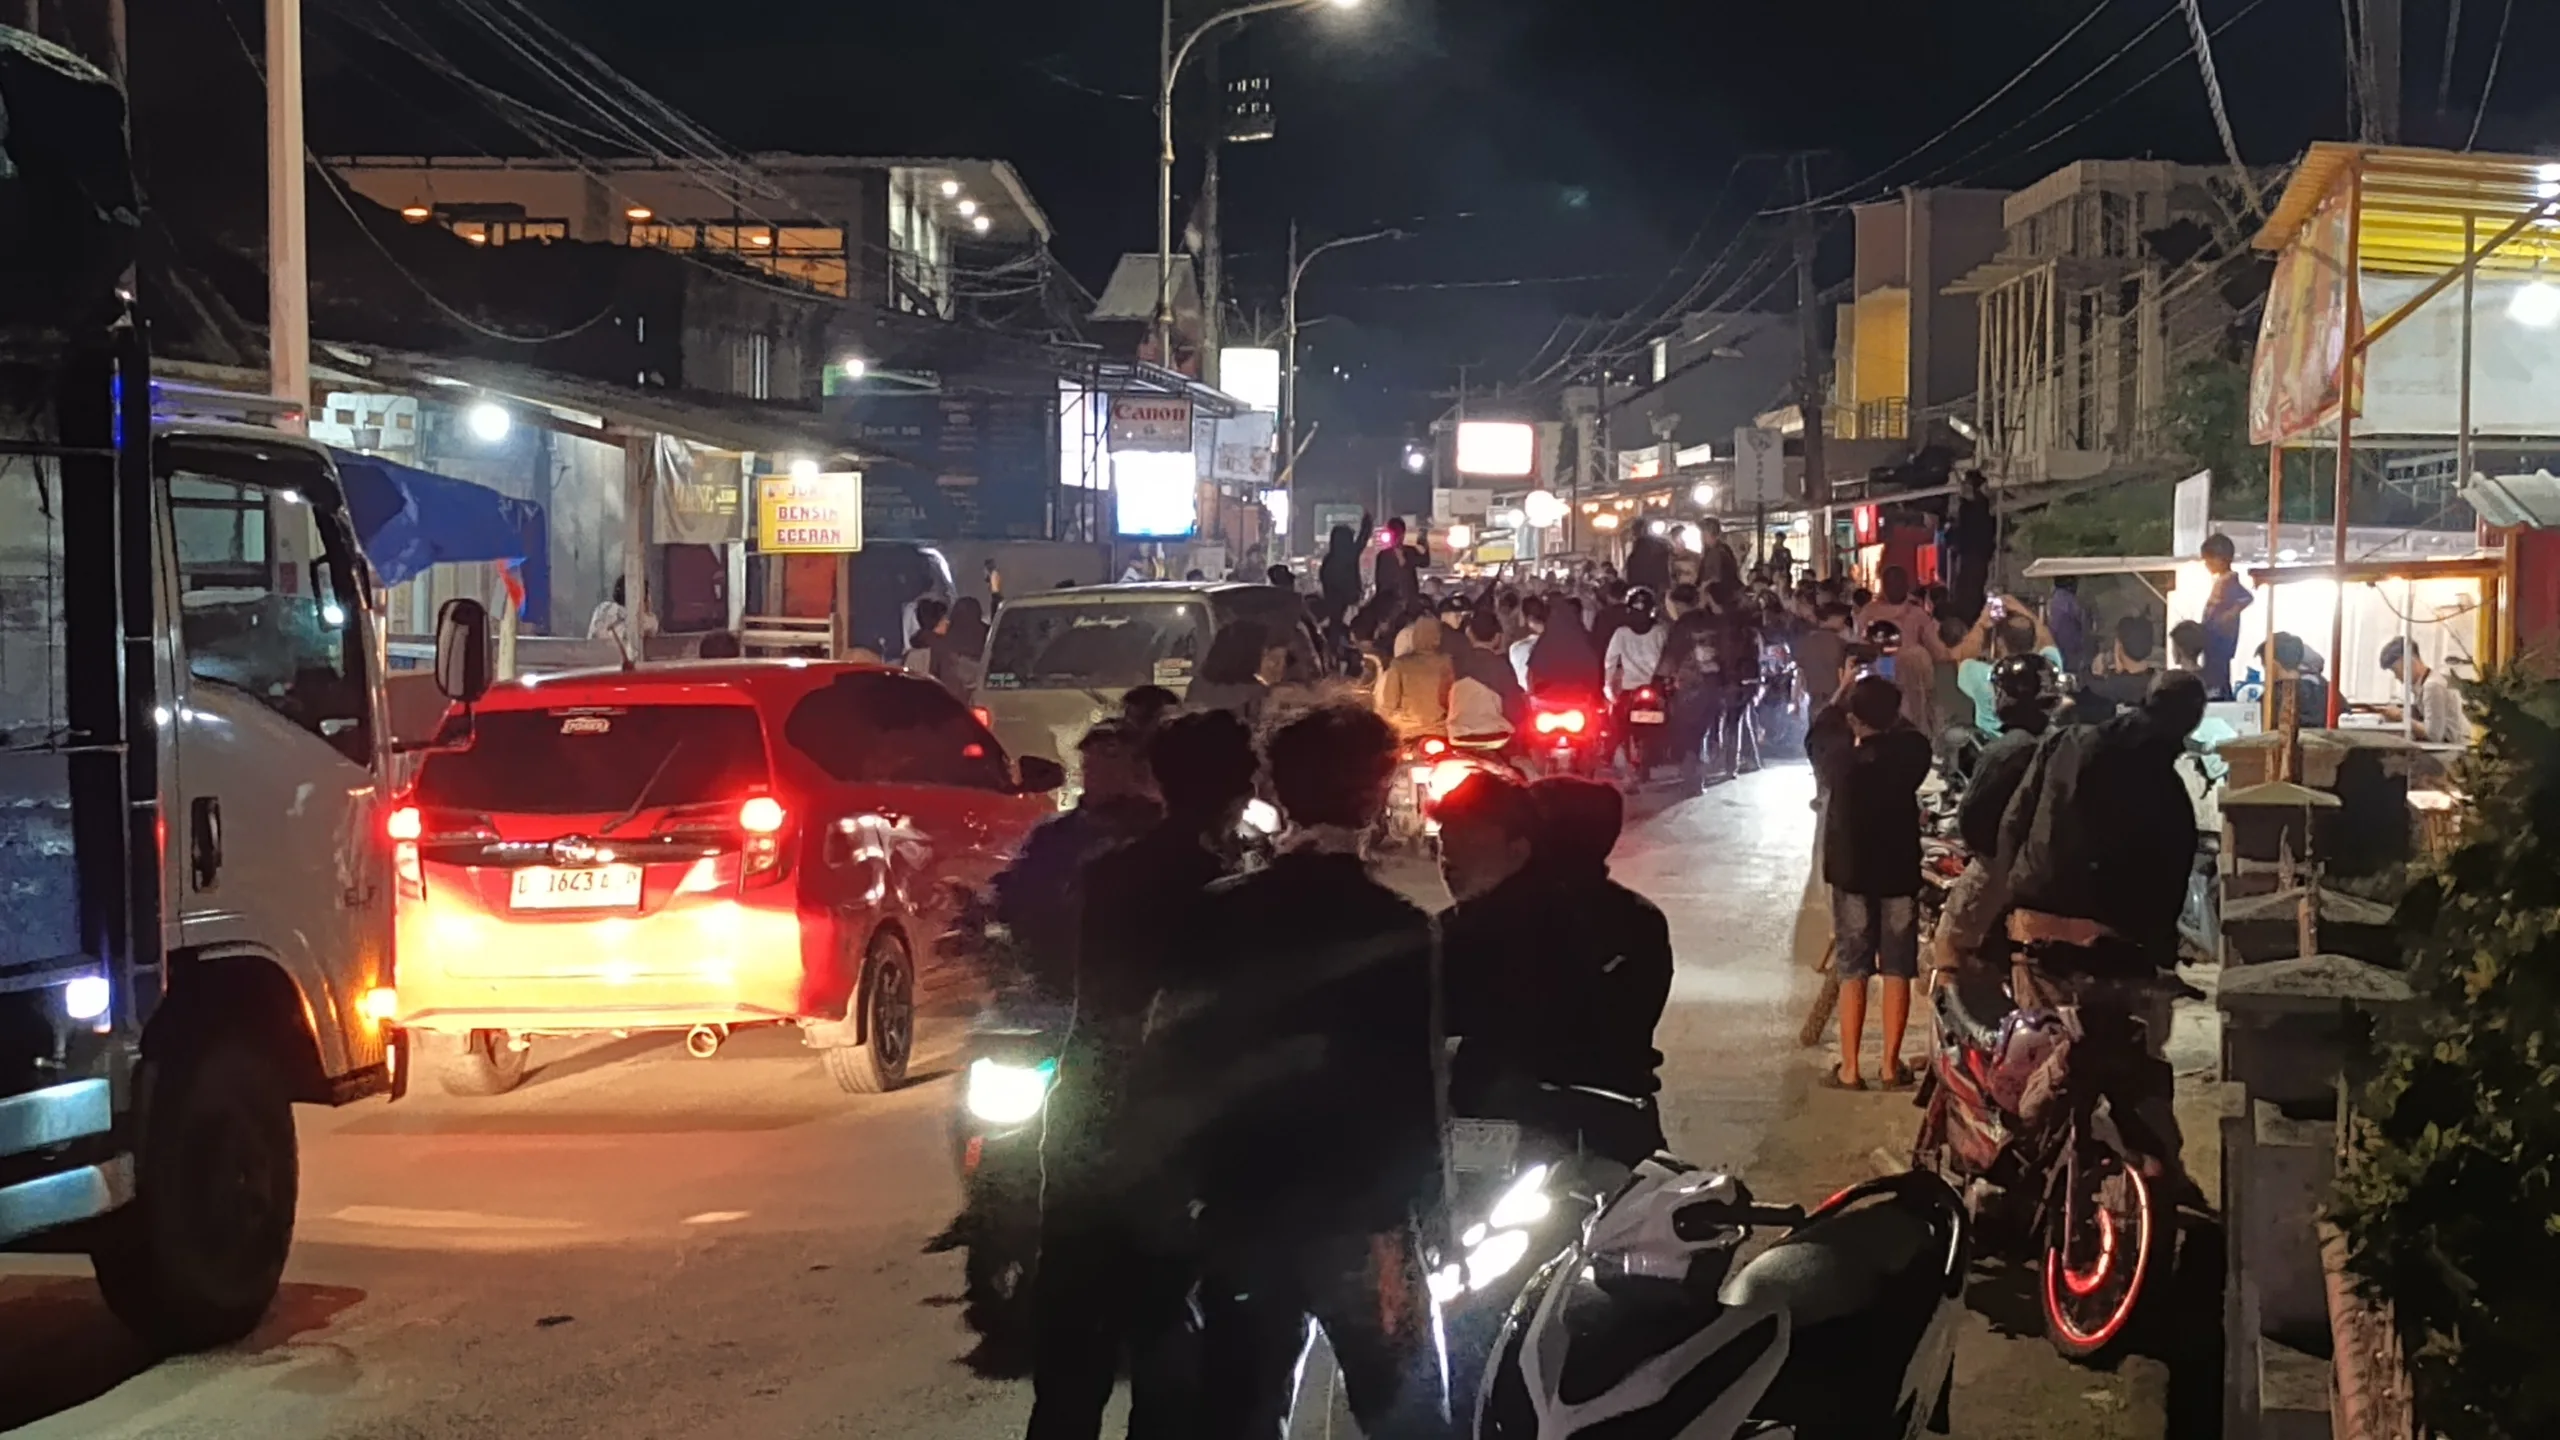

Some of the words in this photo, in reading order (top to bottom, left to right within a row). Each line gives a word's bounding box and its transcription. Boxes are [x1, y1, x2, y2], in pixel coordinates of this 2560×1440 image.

[1114, 404, 1186, 421] Canon
[778, 506, 838, 521] BENSIN
[776, 529, 841, 544] ECERAN
